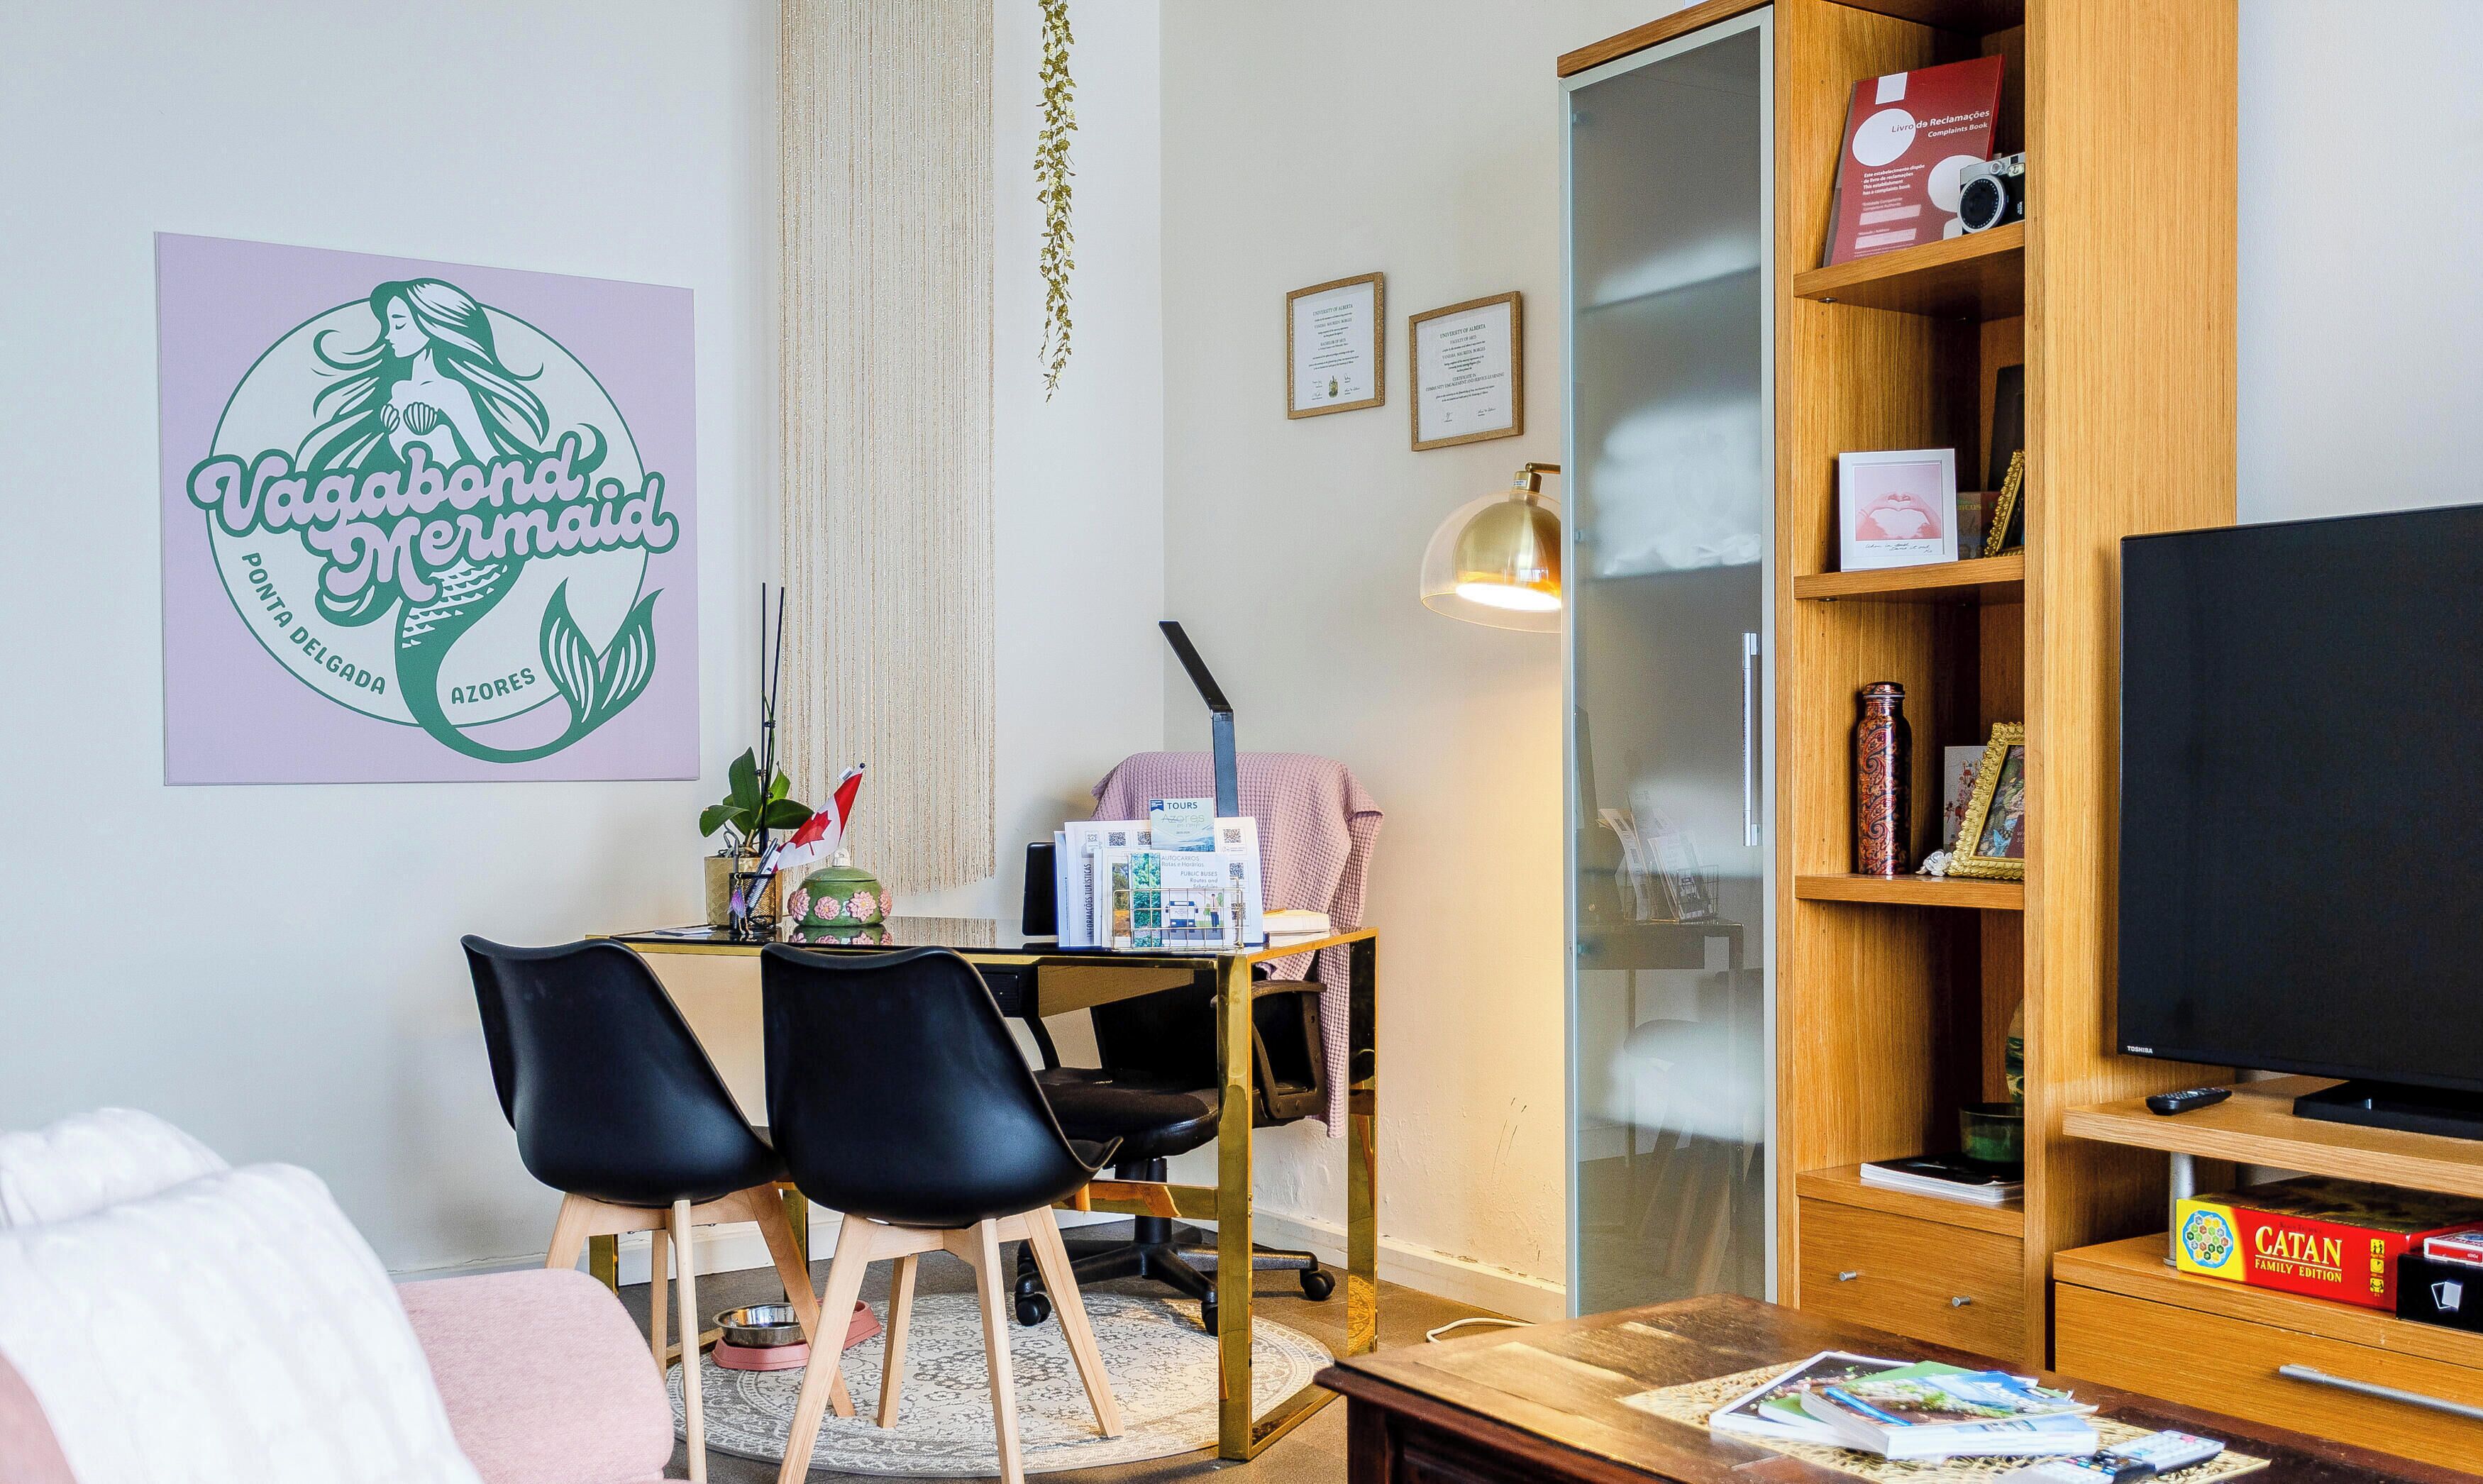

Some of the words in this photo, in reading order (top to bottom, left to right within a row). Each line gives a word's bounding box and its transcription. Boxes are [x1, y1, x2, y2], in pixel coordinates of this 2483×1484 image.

[1891, 123, 1913, 133] Livro
[1930, 110, 1990, 126] Reclamações
[1928, 126, 1967, 138] Complaints
[1969, 122, 1988, 131] Book
[1439, 329, 1462, 338] UNIVERSITY
[188, 432, 589, 555] Vagabond
[321, 472, 678, 604] Mermaid
[242, 553, 293, 628] PONTA
[289, 626, 385, 694] DELGADA
[451, 668, 536, 704] AZORES
[1162, 814, 1205, 823] Azores
[1083, 863, 1093, 895] TURÍSTICAS
[1084, 896, 1094, 937] INFORMAÇÕES
[2127, 1046, 2153, 1054] TOSHIBA
[2255, 1225, 2342, 1268] CATAN
[2255, 1258, 2293, 1274] FAMILY
[2299, 1266, 2342, 1283] EDITION
